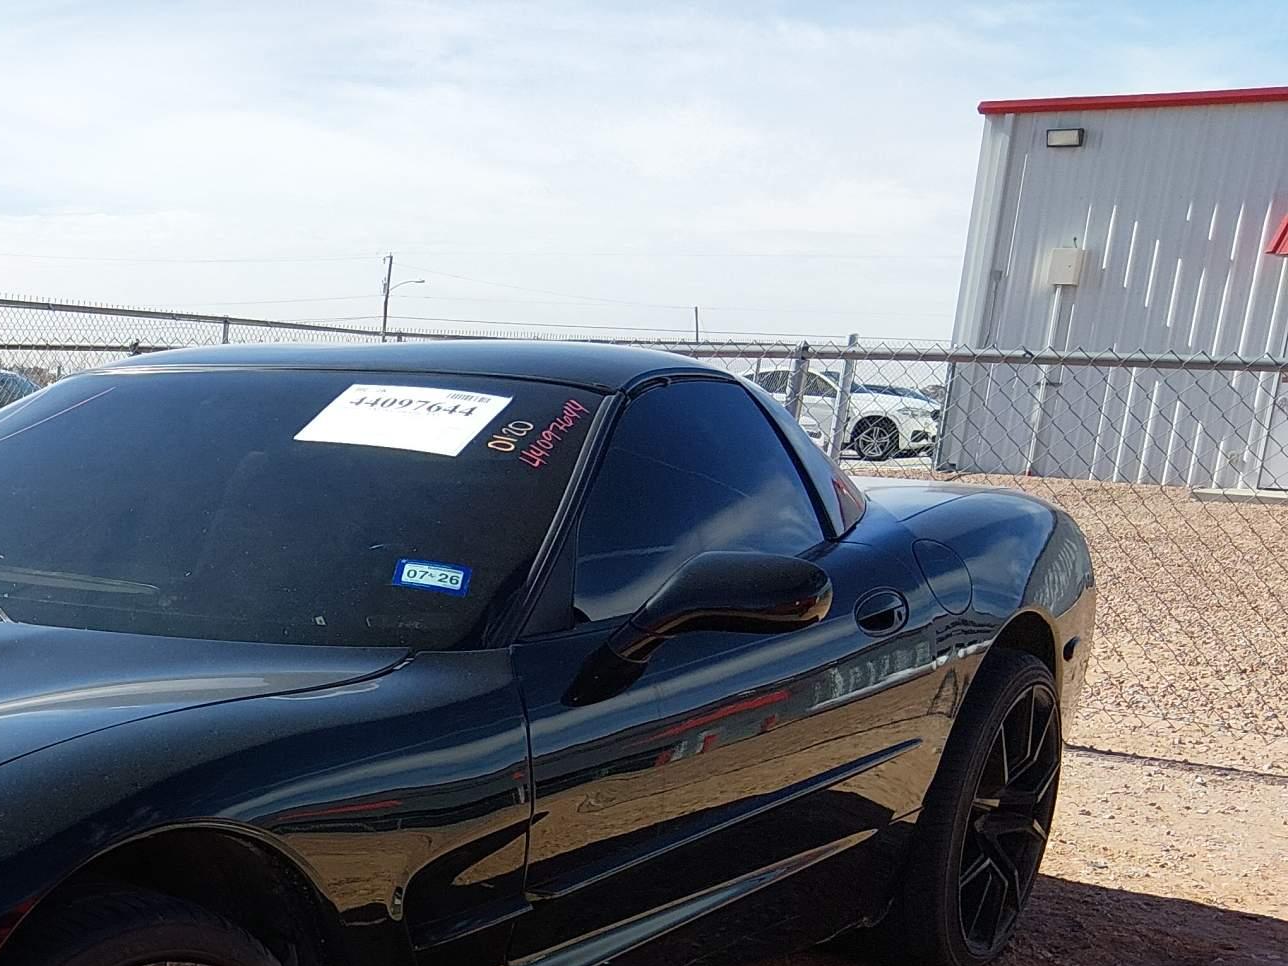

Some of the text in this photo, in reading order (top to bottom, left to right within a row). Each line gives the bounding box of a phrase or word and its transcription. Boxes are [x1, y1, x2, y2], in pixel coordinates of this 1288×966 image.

[349, 396, 478, 417] 44097644
[519, 399, 590, 468] 44097644
[406, 569, 460, 585] 07 26
